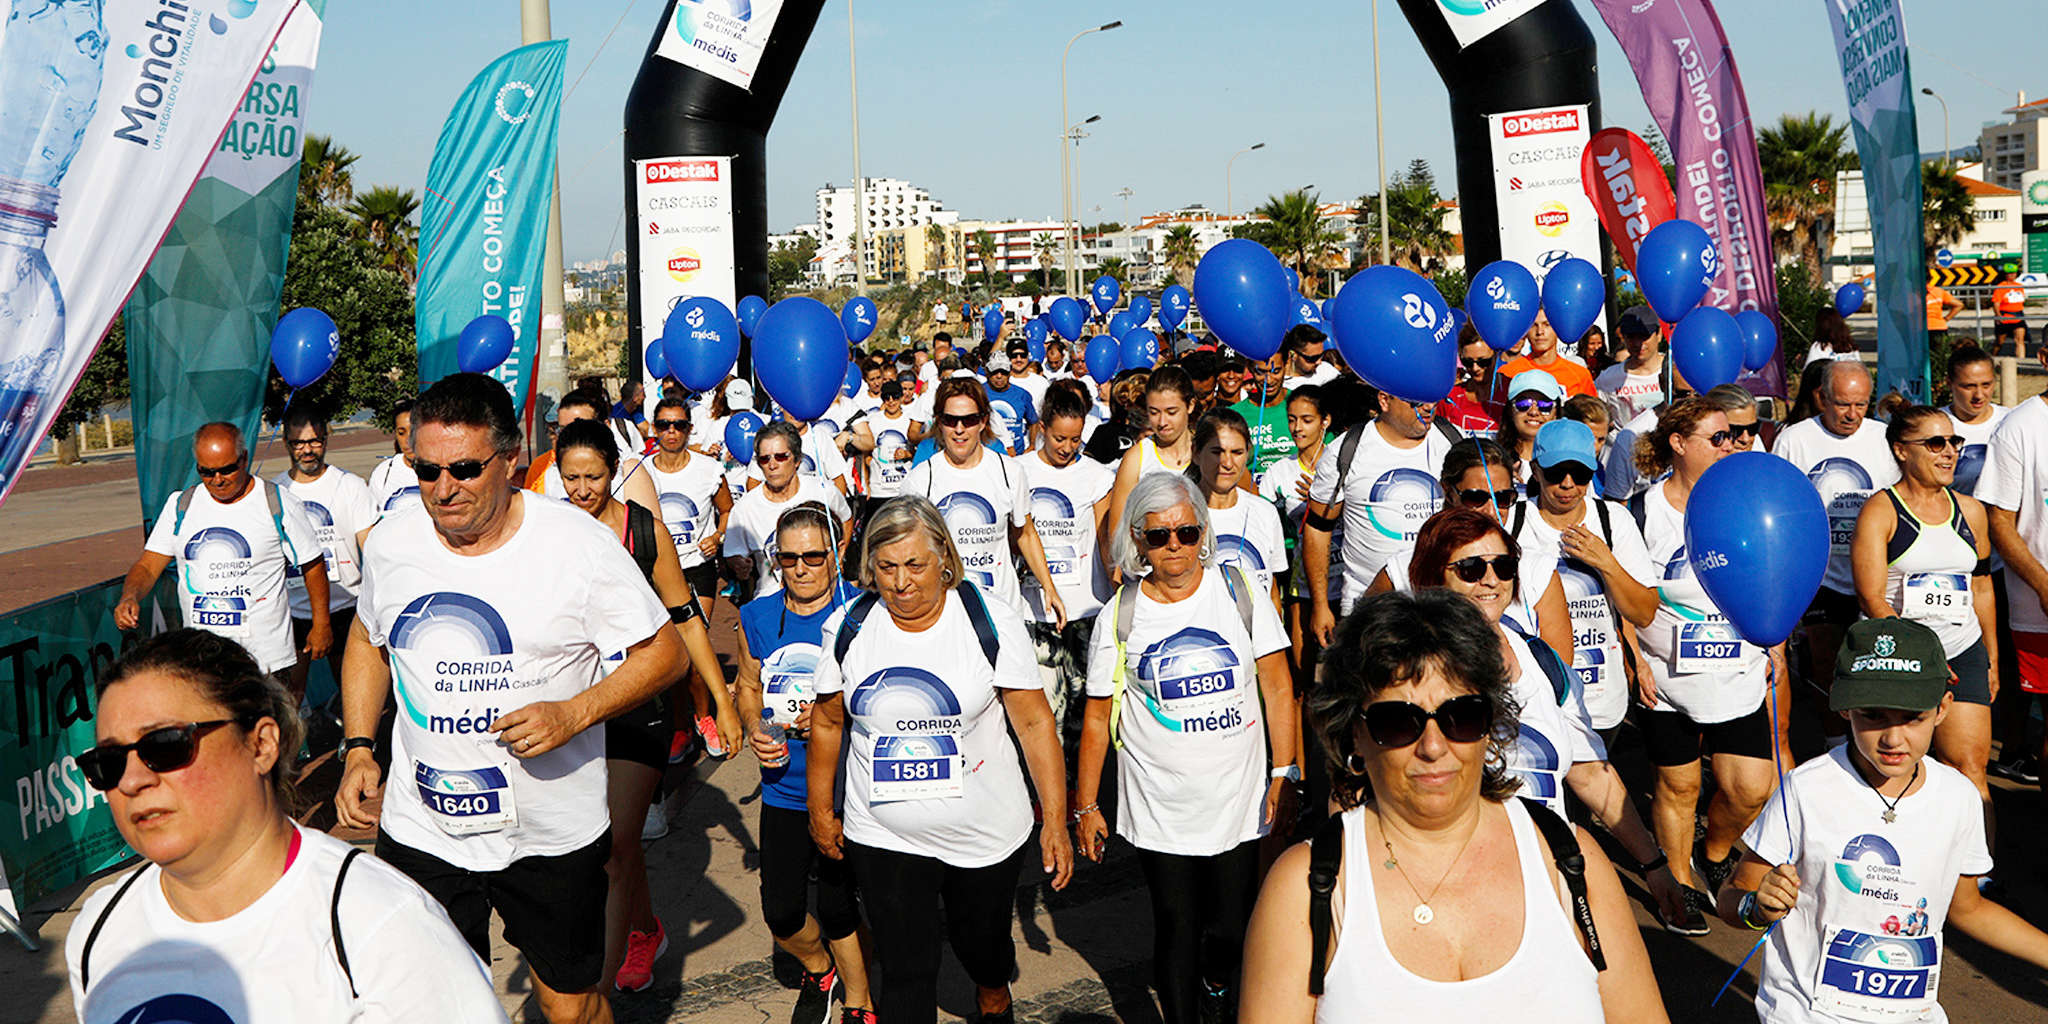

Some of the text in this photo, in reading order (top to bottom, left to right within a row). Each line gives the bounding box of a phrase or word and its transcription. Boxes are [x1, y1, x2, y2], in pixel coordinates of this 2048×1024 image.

[706, 11, 747, 32] CORRIDA
[693, 38, 738, 63] médis
[153, 8, 203, 151] UM SEGREDO DE VITALIDADE
[237, 81, 298, 118] RSA
[1519, 113, 1577, 132] Destak
[220, 117, 296, 160] AÇÃO
[1508, 146, 1580, 165] CASCAIS
[659, 163, 717, 180] Destak
[648, 195, 718, 211] CASCAIS
[483, 165, 507, 273] COMEÇA
[1537, 212, 1567, 226] Lipton
[670, 259, 699, 270] Lipton
[1493, 301, 1521, 311] médis
[692, 329, 721, 343] médis
[958, 527, 996, 536] CORRIDA
[1036, 520, 1075, 528] CORRIDA
[209, 561, 251, 570] CORRIDA
[1925, 593, 1952, 606] 815
[202, 613, 234, 625] 1921
[1570, 610, 1604, 618] LINHA
[1694, 643, 1735, 657] 1907
[436, 660, 514, 675] CORRIDA
[1851, 658, 1921, 672] SPORTING
[435, 679, 453, 692] da
[459, 677, 510, 692] LINHA
[1177, 674, 1226, 697] 1580
[896, 719, 962, 731] CORRIDA
[1184, 707, 1242, 733] médis
[891, 761, 938, 780] 1581
[432, 795, 489, 814] 1640
[1866, 864, 1900, 875] CORRIDA
[1877, 874, 1899, 882] LINHA
[1861, 887, 1899, 901] médis
[1851, 969, 1919, 996] 1977
